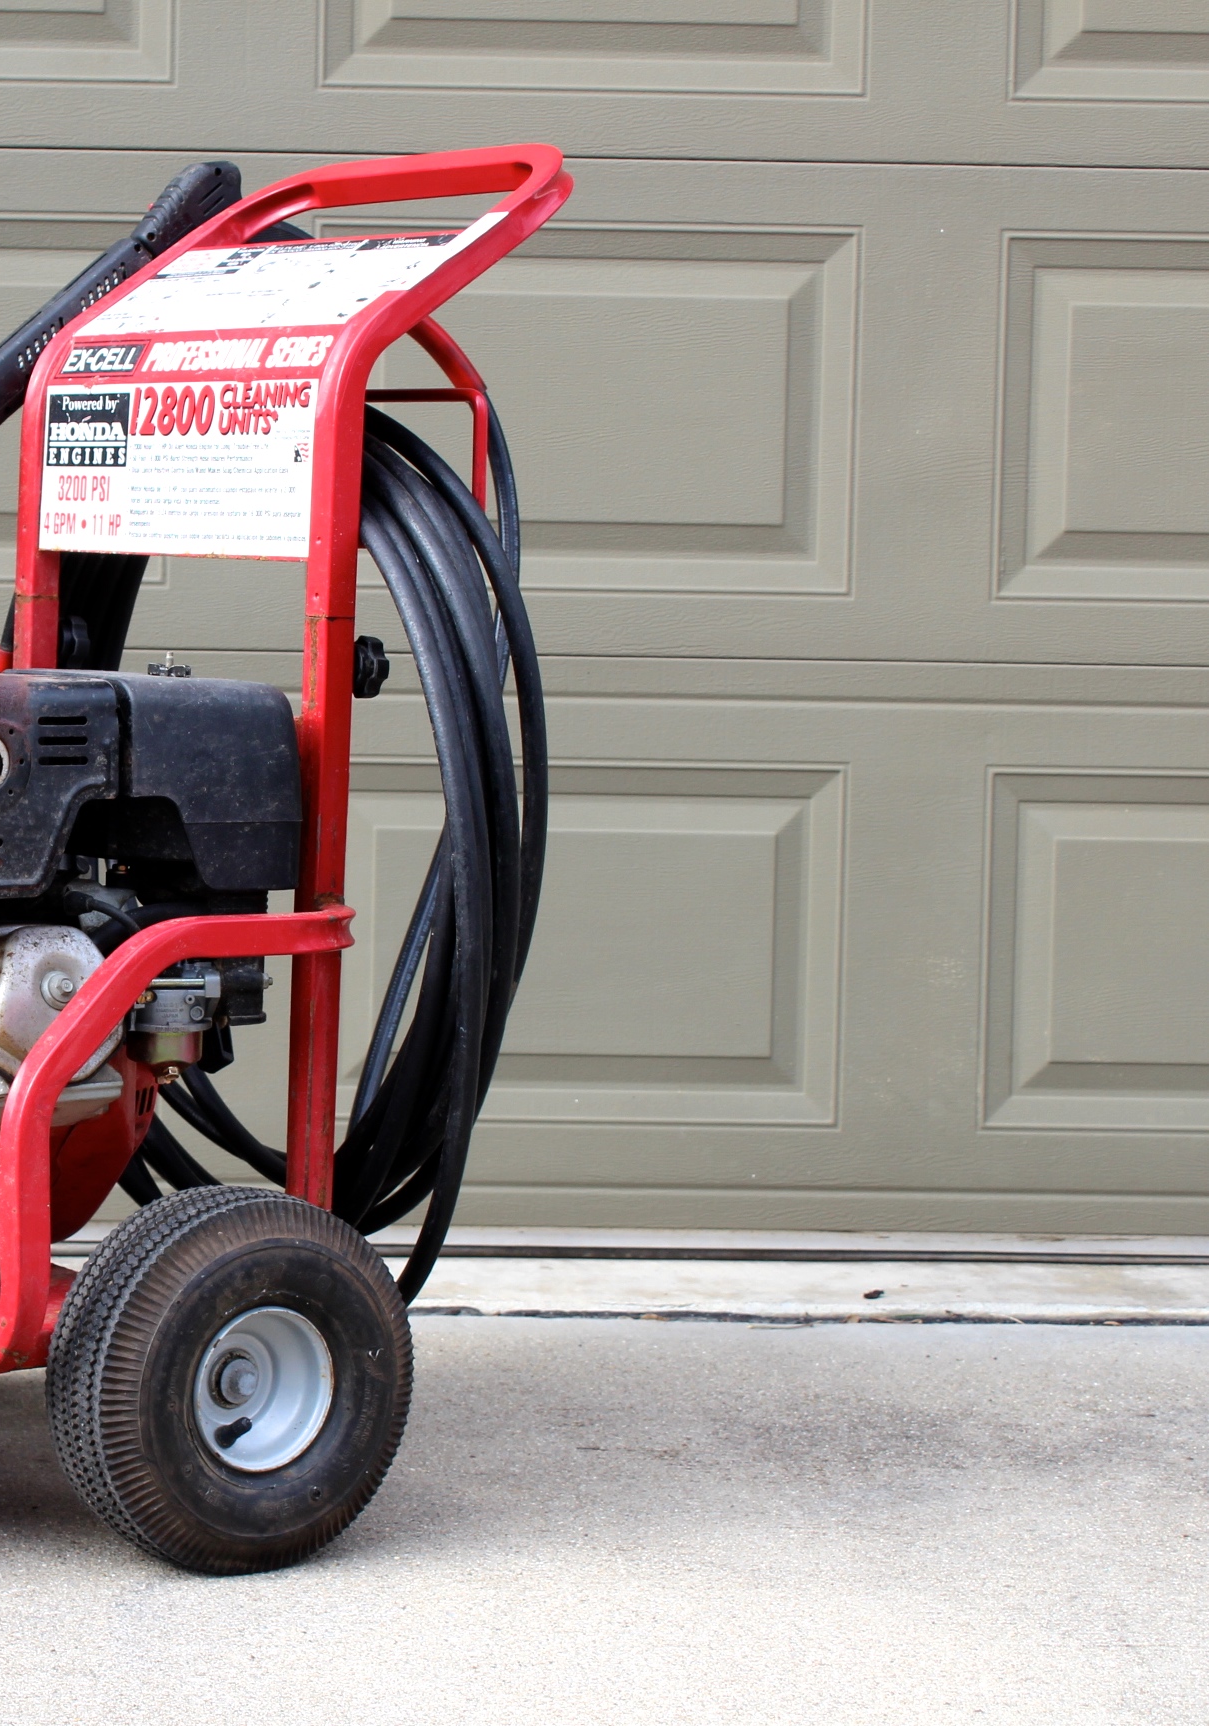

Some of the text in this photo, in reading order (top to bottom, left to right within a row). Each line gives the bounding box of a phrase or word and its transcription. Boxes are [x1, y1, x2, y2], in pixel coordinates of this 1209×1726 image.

[61, 347, 136, 373] EX-CELL
[141, 334, 334, 372] PROFESSIONAL SERIES
[62, 396, 117, 413] Powered by
[220, 381, 311, 409] CLEANING
[129, 385, 215, 436] 12800
[49, 421, 126, 441] HONDA
[48, 447, 126, 465] ENGINES
[58, 475, 110, 502] 3200 PSI
[44, 512, 122, 536] 4 GPM 11 HP
